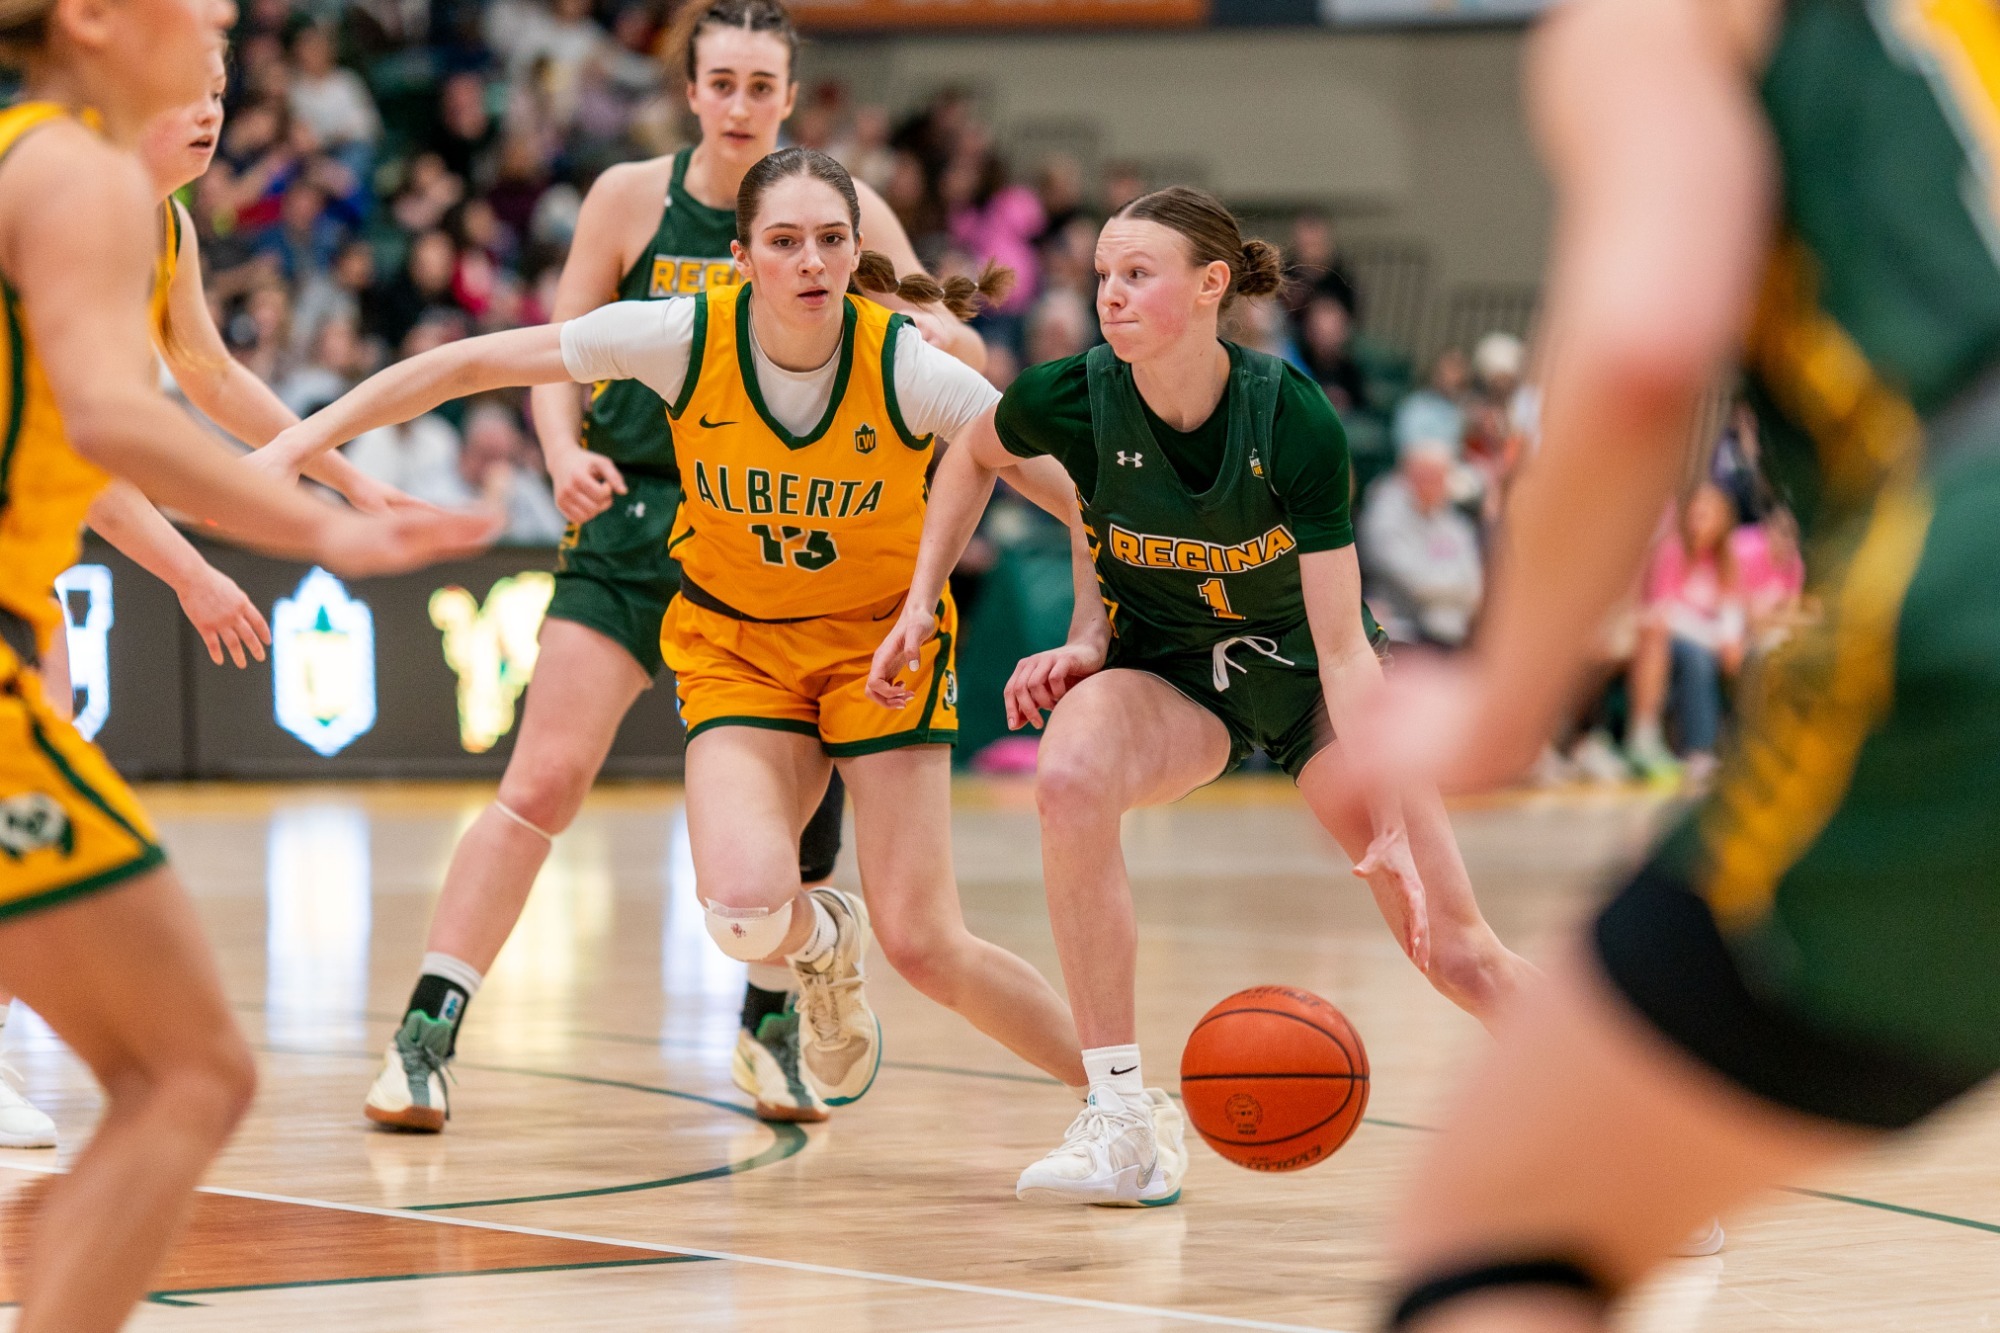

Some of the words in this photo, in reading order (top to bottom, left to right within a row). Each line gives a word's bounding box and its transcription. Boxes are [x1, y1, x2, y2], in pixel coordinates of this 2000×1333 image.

[649, 253, 742, 298] REG
[857, 433, 875, 450] CW
[695, 459, 885, 518] ALBERTA
[748, 523, 840, 572] 13
[1109, 523, 1297, 573] REGINA
[1198, 578, 1246, 620] 1
